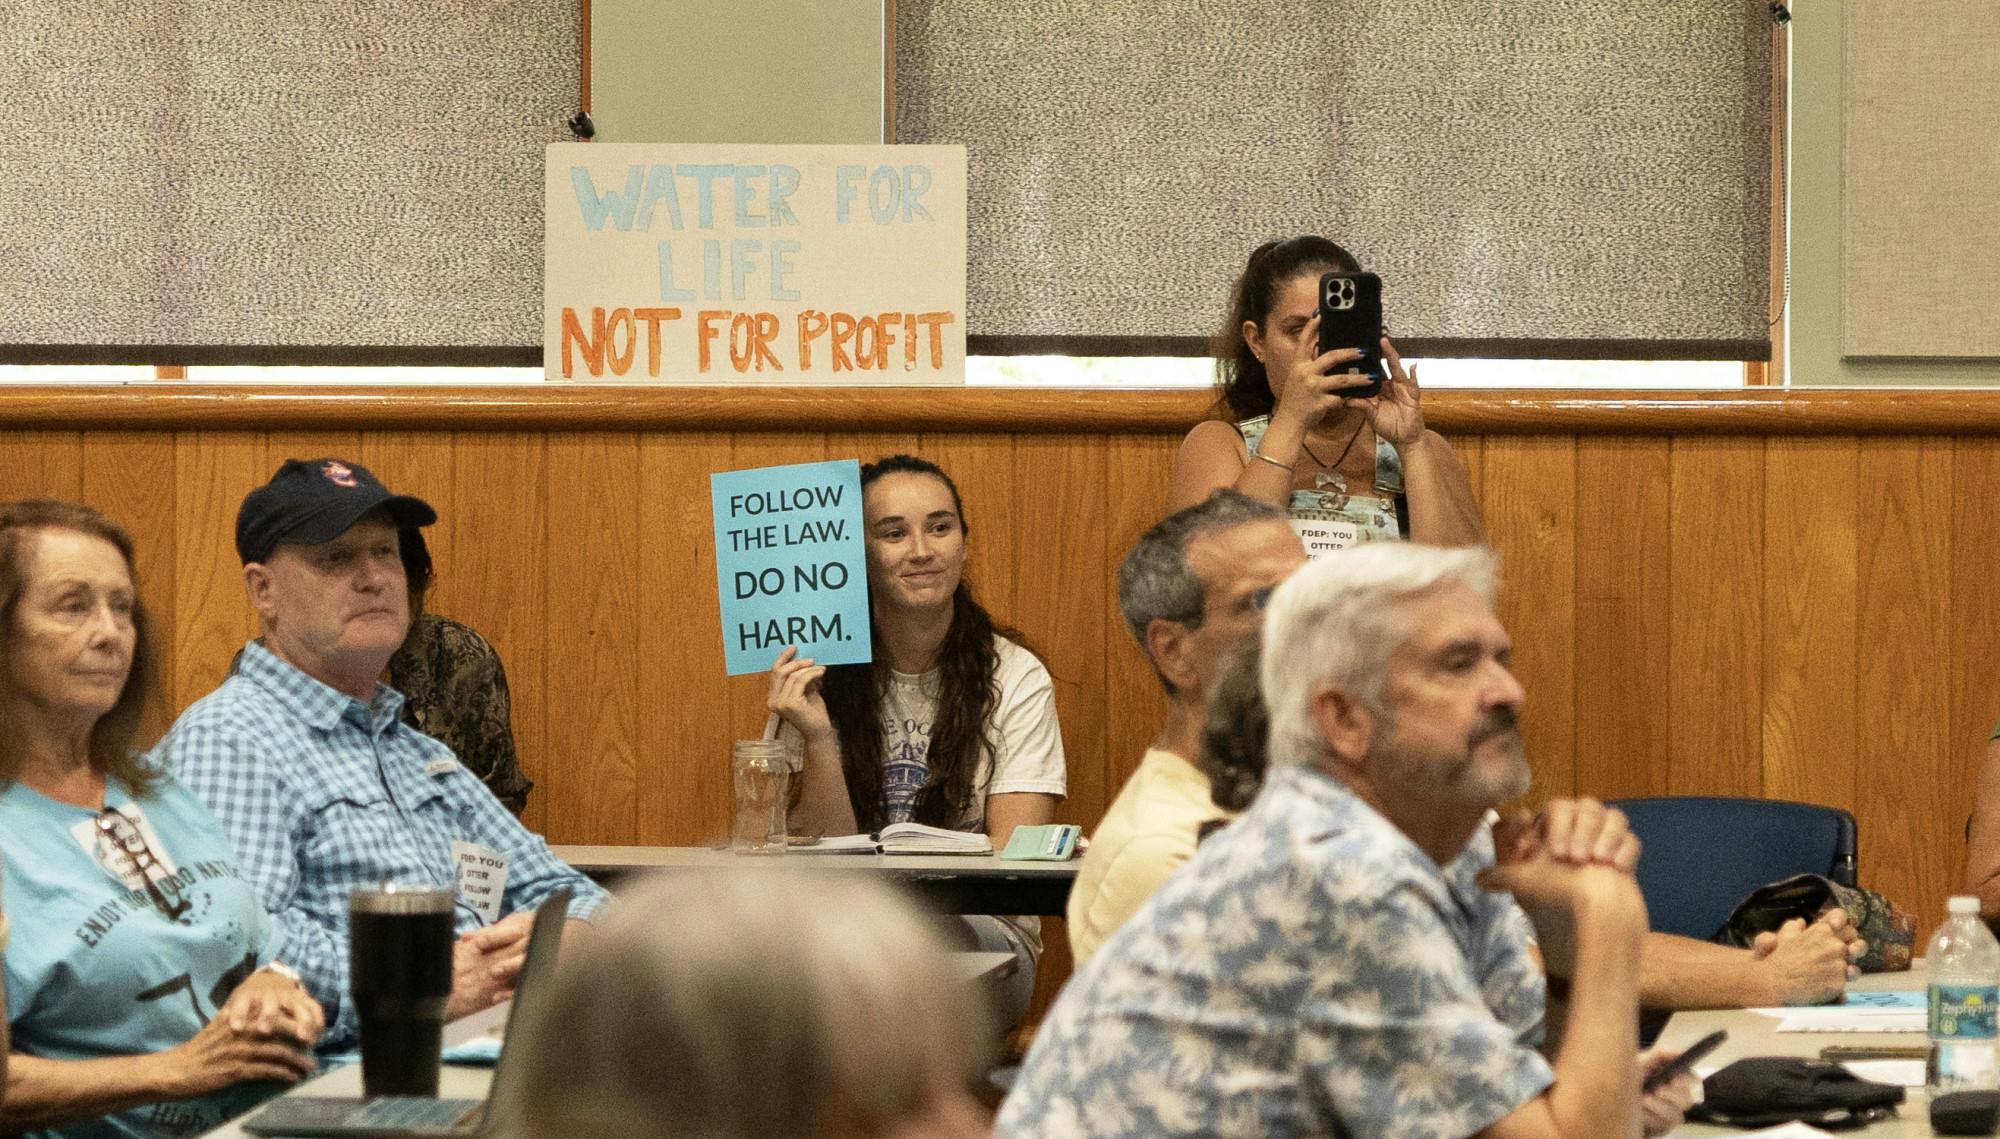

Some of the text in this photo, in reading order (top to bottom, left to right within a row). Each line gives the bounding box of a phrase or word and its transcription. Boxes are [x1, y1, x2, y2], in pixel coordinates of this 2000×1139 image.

[571, 164, 935, 232] WATER FOR
[657, 239, 801, 302] LIFE
[561, 307, 956, 379] NOT FOR PROFIT
[730, 485, 845, 519] FOLLOW
[727, 518, 851, 552] THE LAW.
[1302, 530, 1352, 540] FDEP: YOU
[734, 561, 849, 601] DO NO
[738, 613, 852, 652] HARM.
[479, 857, 503, 869] YOU
[75, 899, 128, 949] ENJOY
